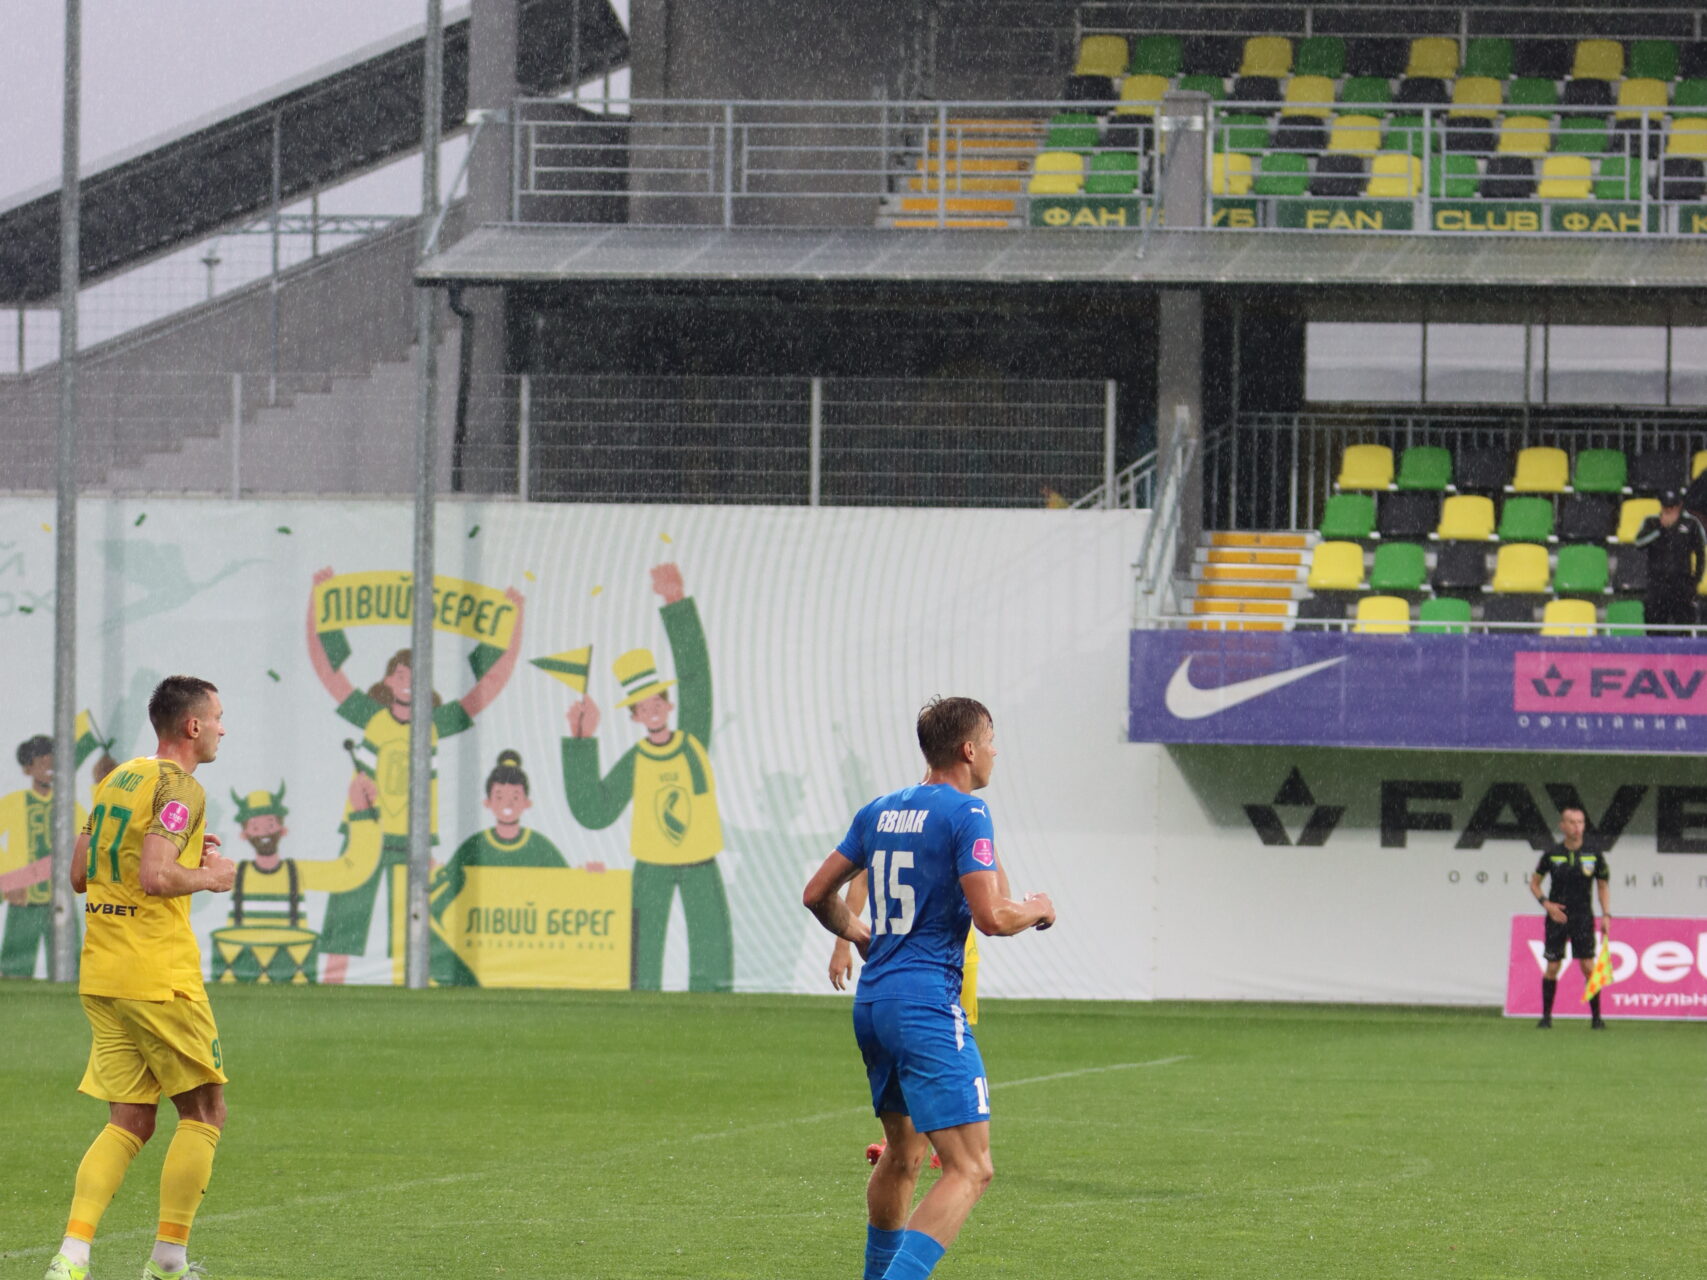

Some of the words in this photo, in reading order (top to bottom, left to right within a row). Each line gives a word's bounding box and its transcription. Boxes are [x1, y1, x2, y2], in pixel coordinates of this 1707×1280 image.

[1042, 206, 1126, 227] ФАН
[1305, 208, 1383, 230] FAN
[1435, 209, 1539, 231] CLUB
[1590, 668, 1706, 699] FAV
[871, 850, 916, 935] 15
[466, 901, 537, 934] ЛІВИЙ
[547, 909, 615, 936] БЕРЕГ
